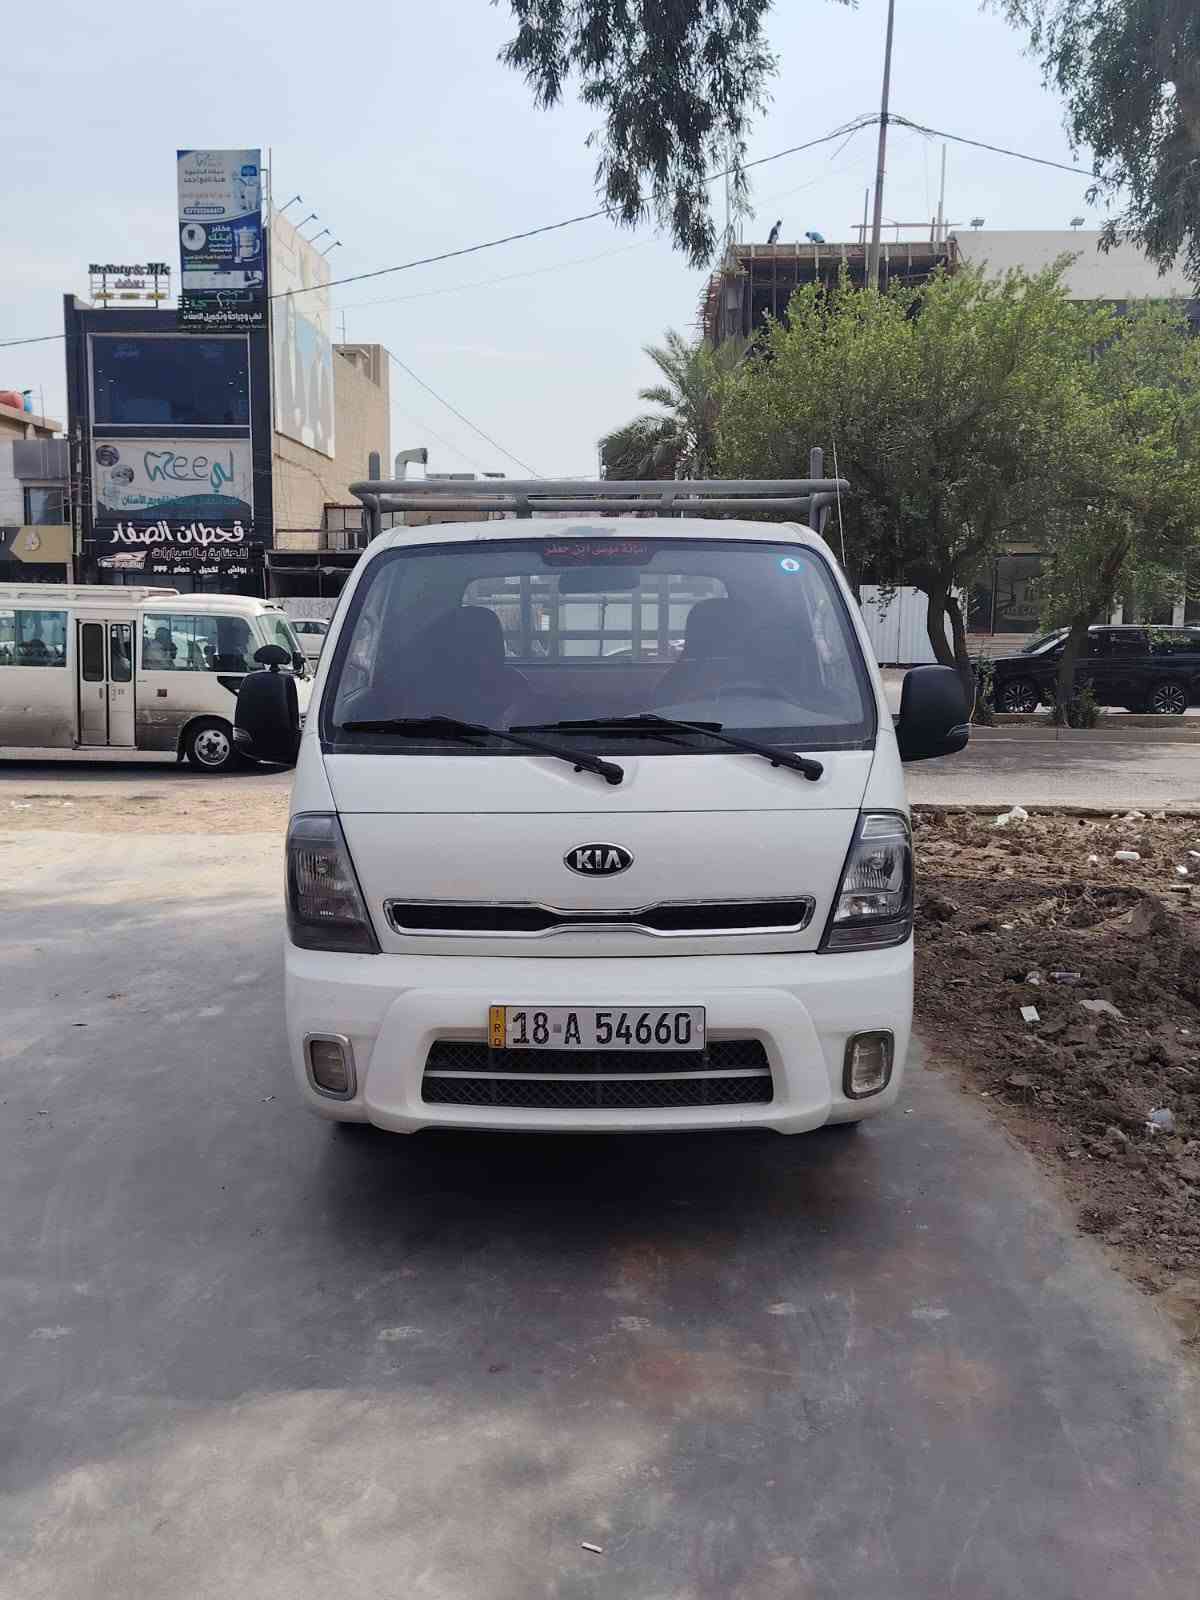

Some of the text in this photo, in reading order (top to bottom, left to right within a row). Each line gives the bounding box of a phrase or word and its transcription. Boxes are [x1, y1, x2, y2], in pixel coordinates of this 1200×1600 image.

[110, 520, 245, 546] قحطان الصفار
[151, 547, 249, 562] للعناية بالسيارات
[576, 850, 622, 868] KIA
[512, 1012, 692, 1045] 18 A 54660
